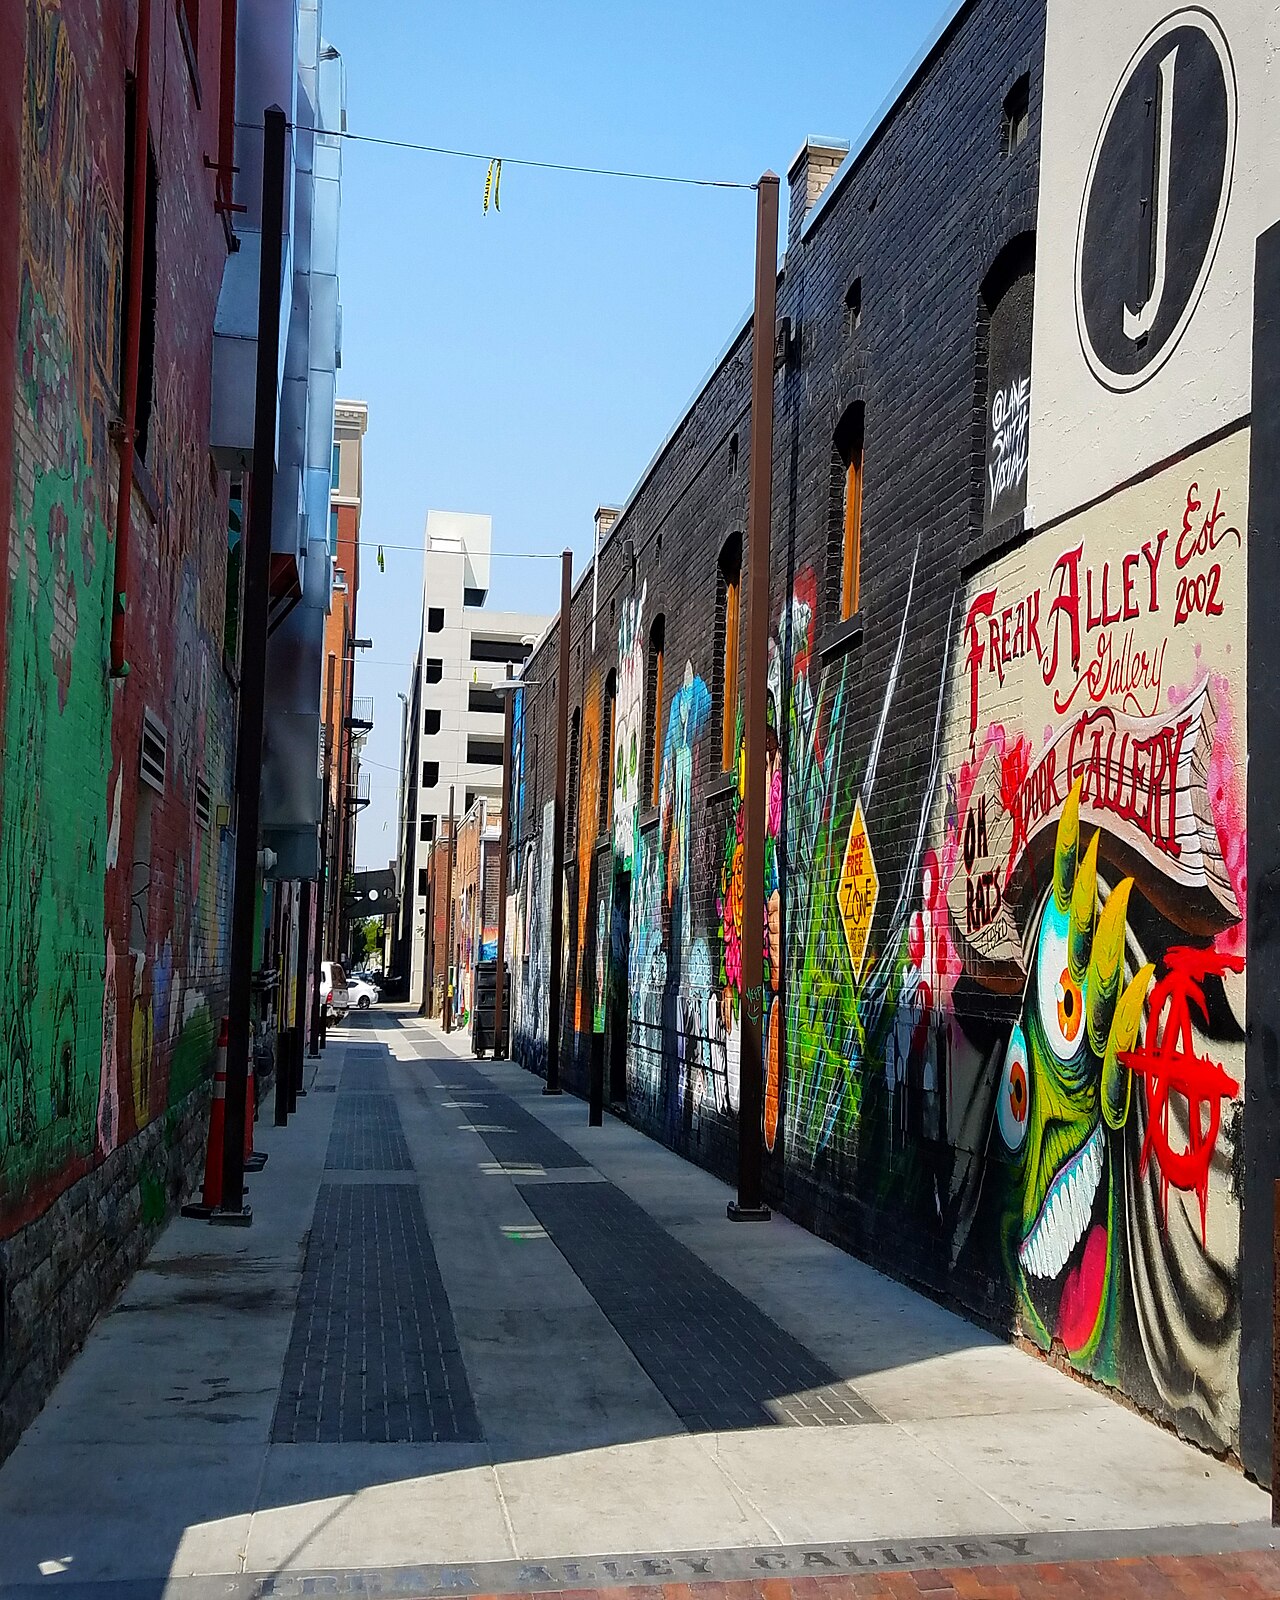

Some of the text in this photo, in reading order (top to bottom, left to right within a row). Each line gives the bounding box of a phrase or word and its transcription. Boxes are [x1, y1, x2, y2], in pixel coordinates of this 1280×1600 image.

[1122, 44, 1180, 340] J
[992, 375, 1031, 432] @LANE
[1174, 482, 1241, 570] Est
[1174, 563, 1223, 627] 2002
[963, 540, 1168, 766] FREAK ALLEY
[1054, 628, 1167, 717] Gallery
[1067, 706, 1192, 858] GALLERY
[846, 852, 863, 876] FREE
[963, 793, 988, 875] OH
[844, 878, 871, 924] ZONE
[966, 865, 1000, 933] RATS
[517, 1556, 713, 1583] ALLEY
[750, 1537, 1033, 1570] GALLERY
